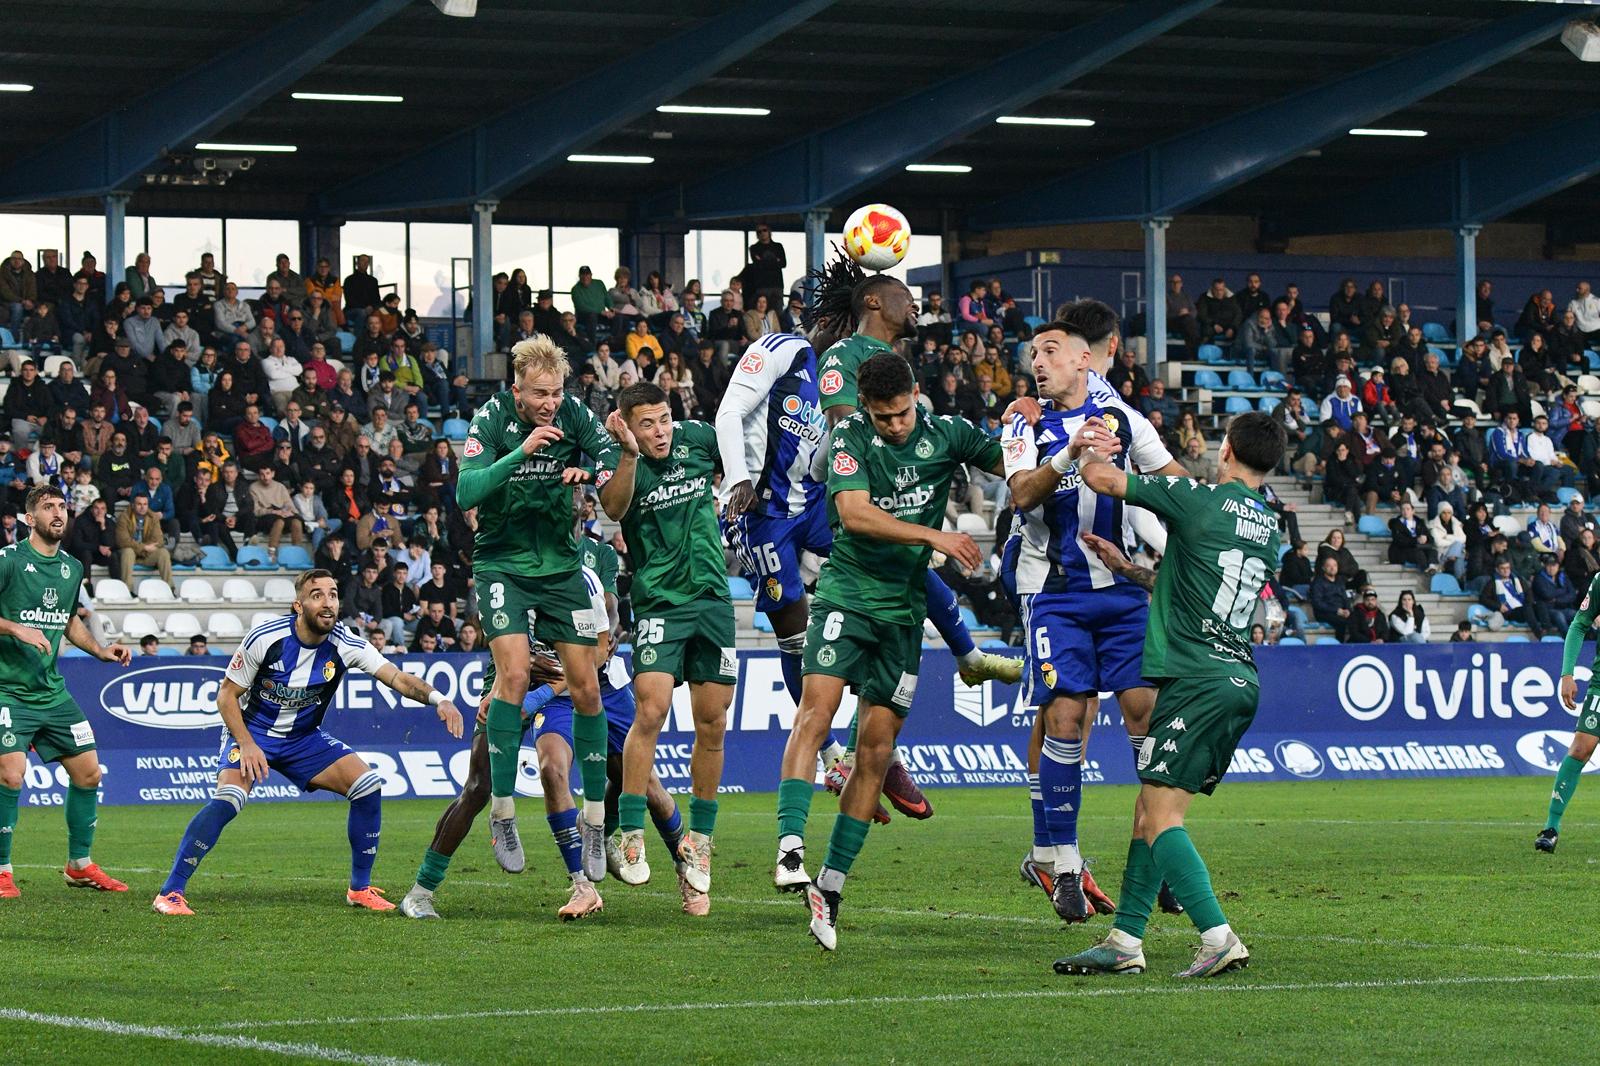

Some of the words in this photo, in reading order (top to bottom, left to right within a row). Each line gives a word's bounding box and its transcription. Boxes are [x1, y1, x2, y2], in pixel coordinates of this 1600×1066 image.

[1235, 517, 1270, 546] MINGO
[752, 542, 782, 576] 16
[490, 582, 505, 609] 3
[1211, 548, 1267, 629] 18
[636, 617, 665, 647] 25
[822, 611, 845, 641] 6
[1036, 626, 1052, 660] 6
[122, 680, 222, 714] VULC
[136, 756, 184, 769] AYUDA
[187, 756, 199, 768] A
[1326, 741, 1505, 772] CASTAÑEIRAS
[139, 785, 206, 801] GESTIÓN
[248, 784, 301, 799] SCINAS
[169, 771, 218, 785] LIMPIE
[940, 772, 961, 784] DE
[963, 771, 1024, 784] RIESGOS
